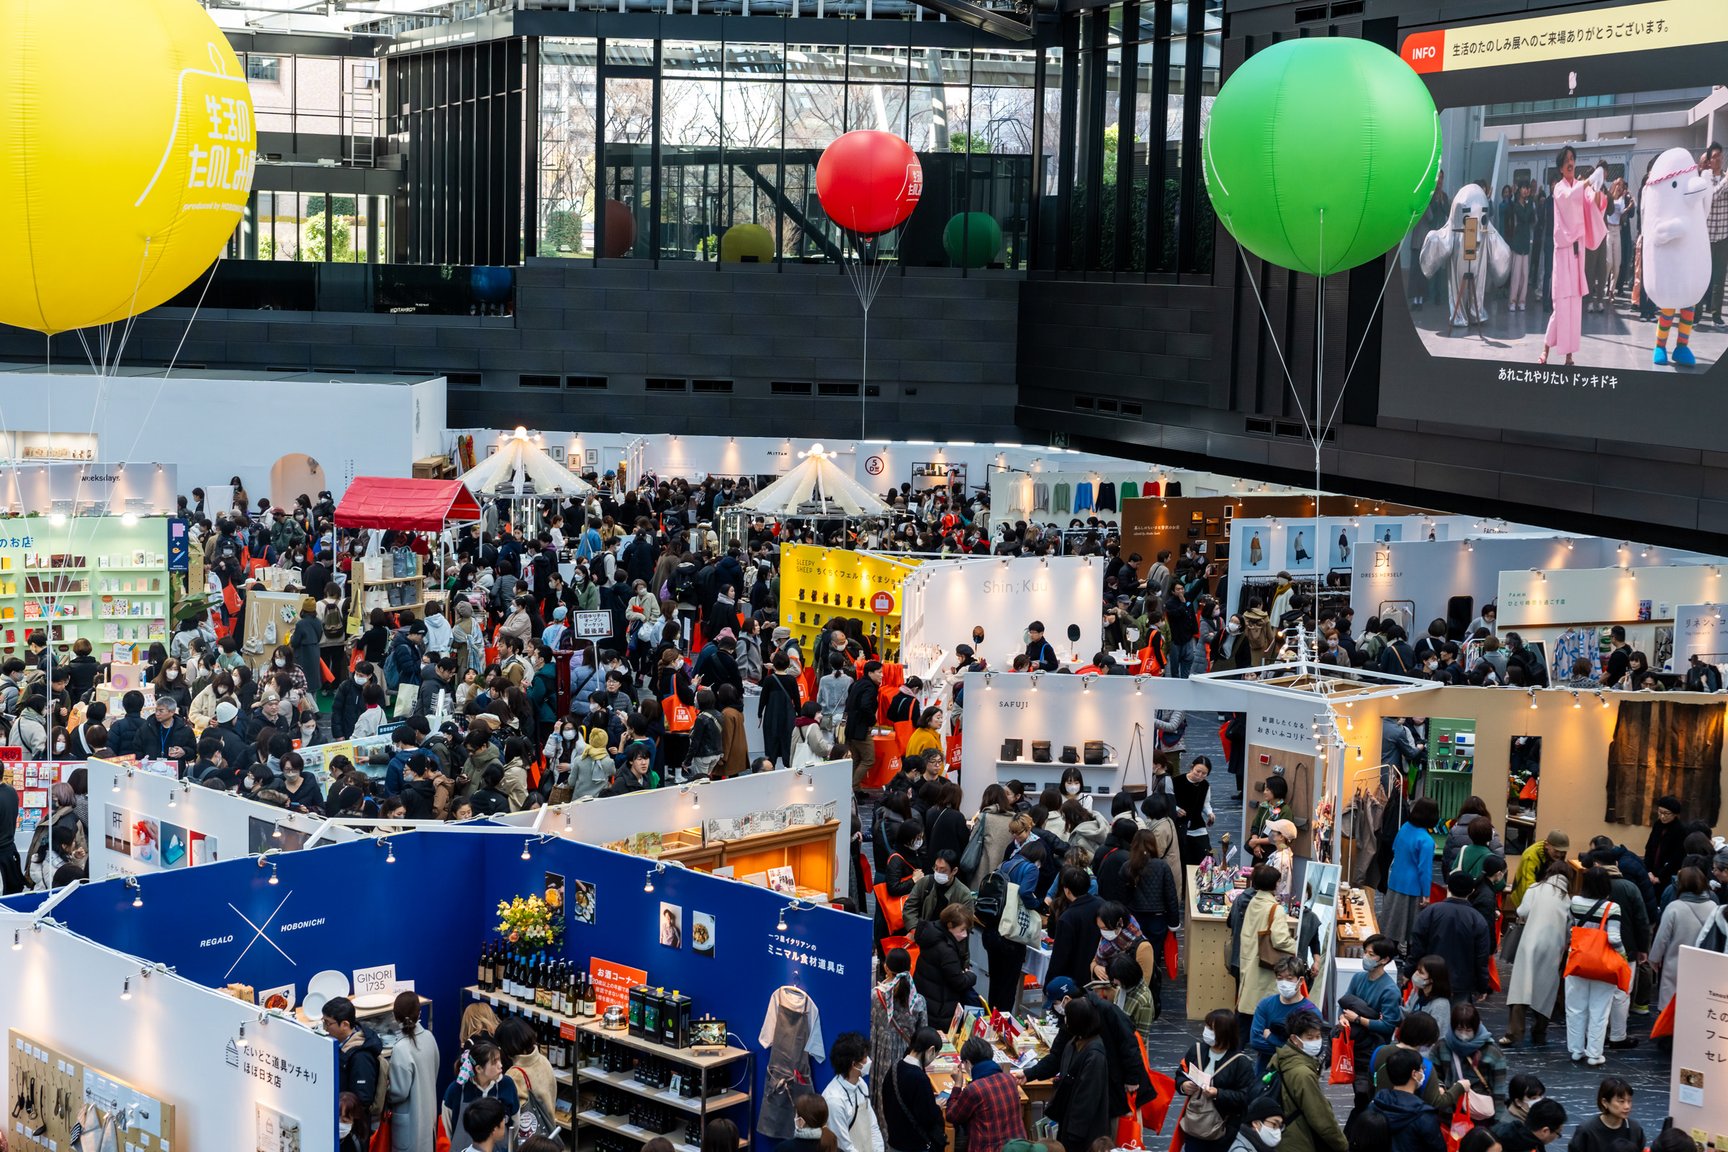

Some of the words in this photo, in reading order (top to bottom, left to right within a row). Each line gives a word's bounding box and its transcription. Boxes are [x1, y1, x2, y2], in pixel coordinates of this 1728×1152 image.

[1452, 19, 1670, 58] 生活のたのしみ展へのご来場ありがとうございます。
[1412, 46, 1436, 60] INFO
[205, 94, 251, 143] 生活の
[1498, 367, 1569, 385] あれこれやりたい
[1573, 373, 1618, 389] ドッキドキ
[81, 474, 120, 482] weeksdays
[796, 559, 816, 567] SLEEPY
[999, 700, 1029, 709] SAFUJI
[1257, 726, 1313, 741] おさいふコリドー
[280, 917, 326, 932] HOBONICHI
[200, 935, 234, 948] REGALO
[768, 944, 845, 975] ミニマル食材道具店
[357, 969, 393, 984] GINORI
[597, 967, 639, 984] お酒コーナー
[365, 981, 386, 992] 1735
[243, 1045, 317, 1084] だいどこ道具ツチキリ
[243, 1061, 282, 1088] ほぼ日支店
